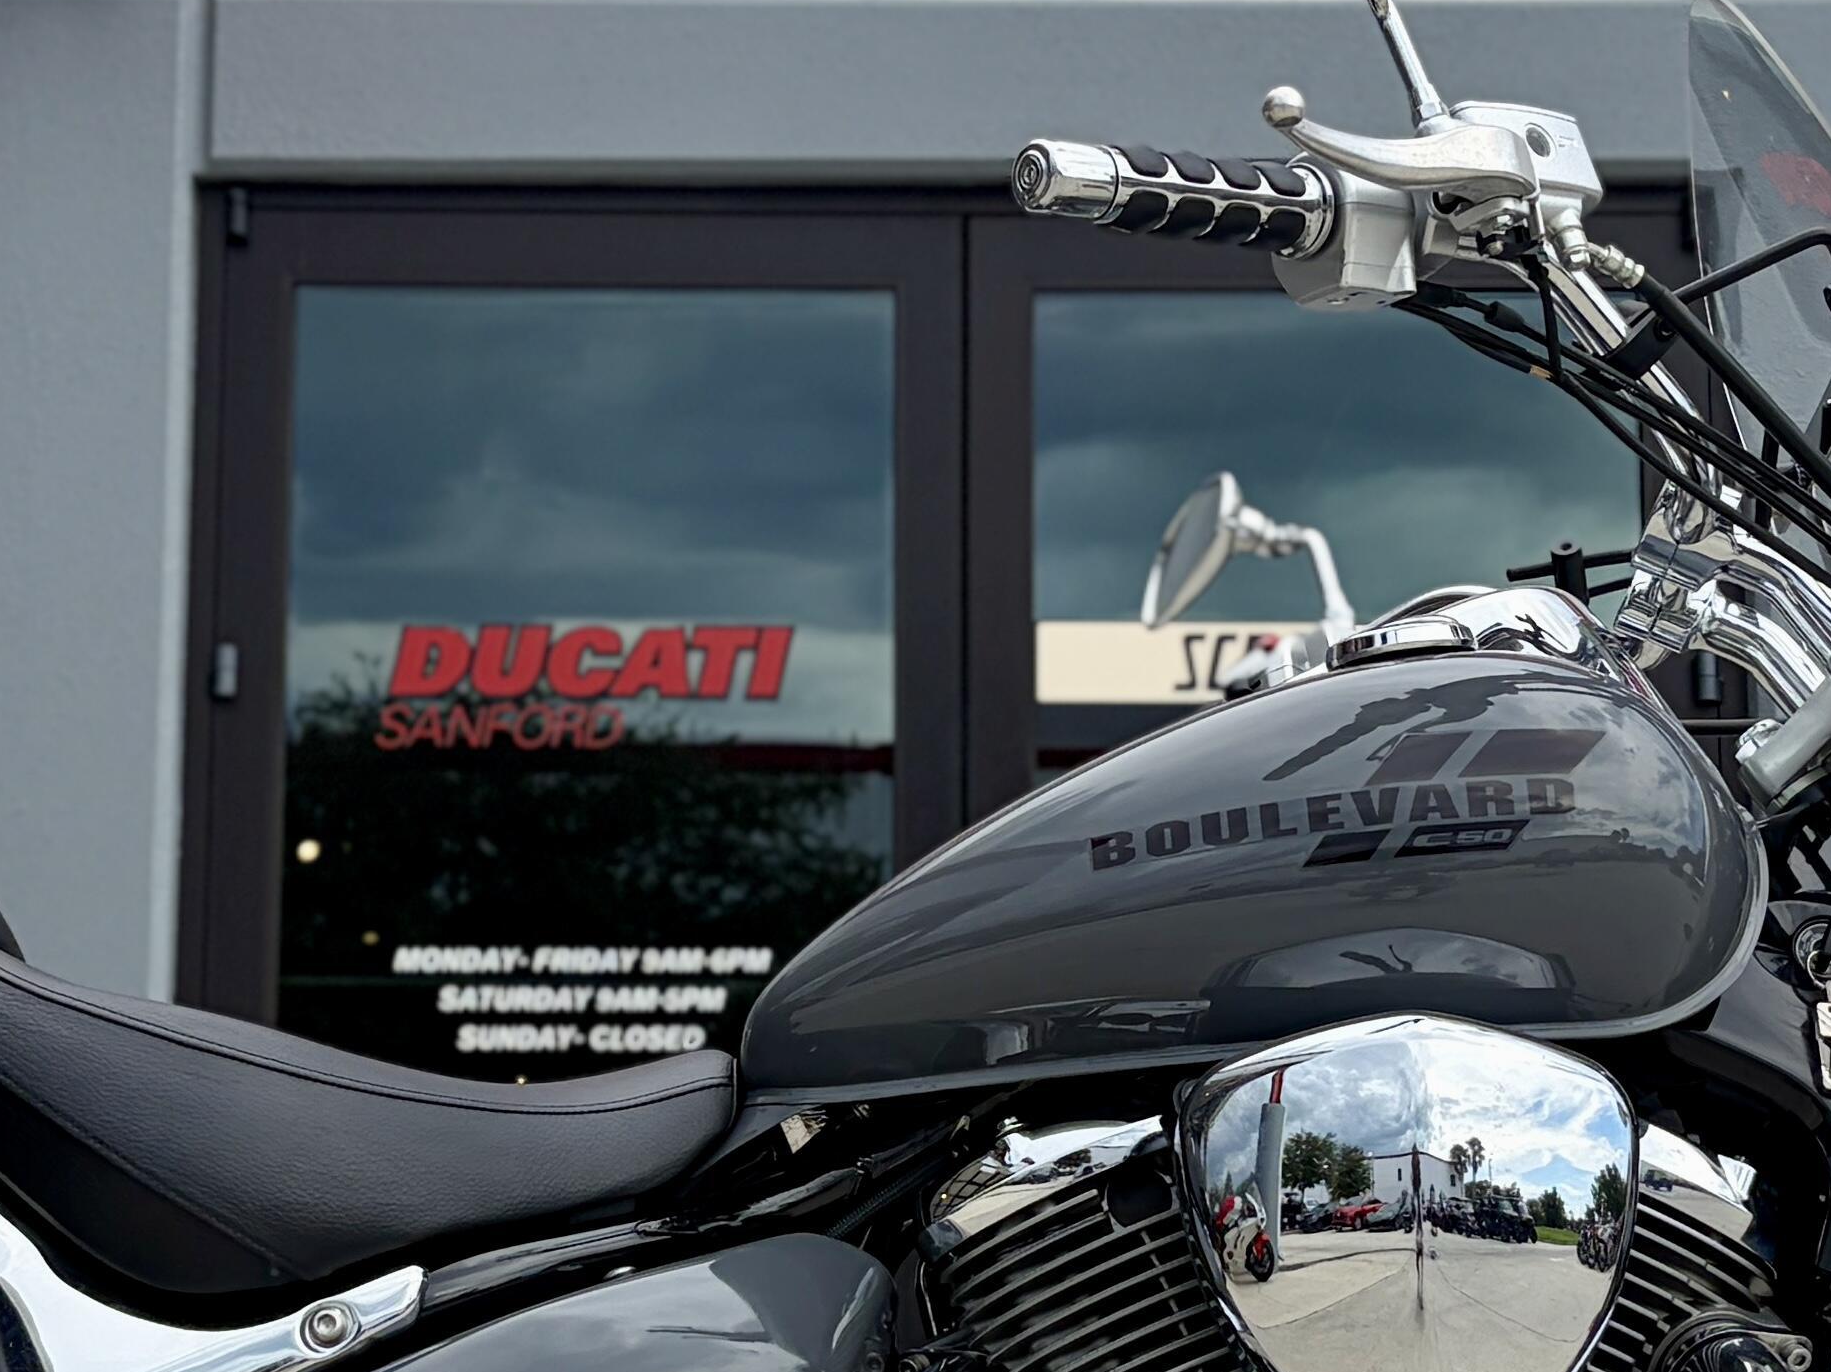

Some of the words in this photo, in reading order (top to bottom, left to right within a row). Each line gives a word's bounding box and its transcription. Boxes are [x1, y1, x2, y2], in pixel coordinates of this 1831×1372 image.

[387, 623, 795, 701] DUCATI
[374, 702, 626, 750] SANFORD
[1089, 777, 1576, 872] BOULEVARD
[531, 946, 639, 974] FRIDAY
[436, 984, 594, 1014] SATURDAY
[588, 1023, 707, 1053] CLOSED
